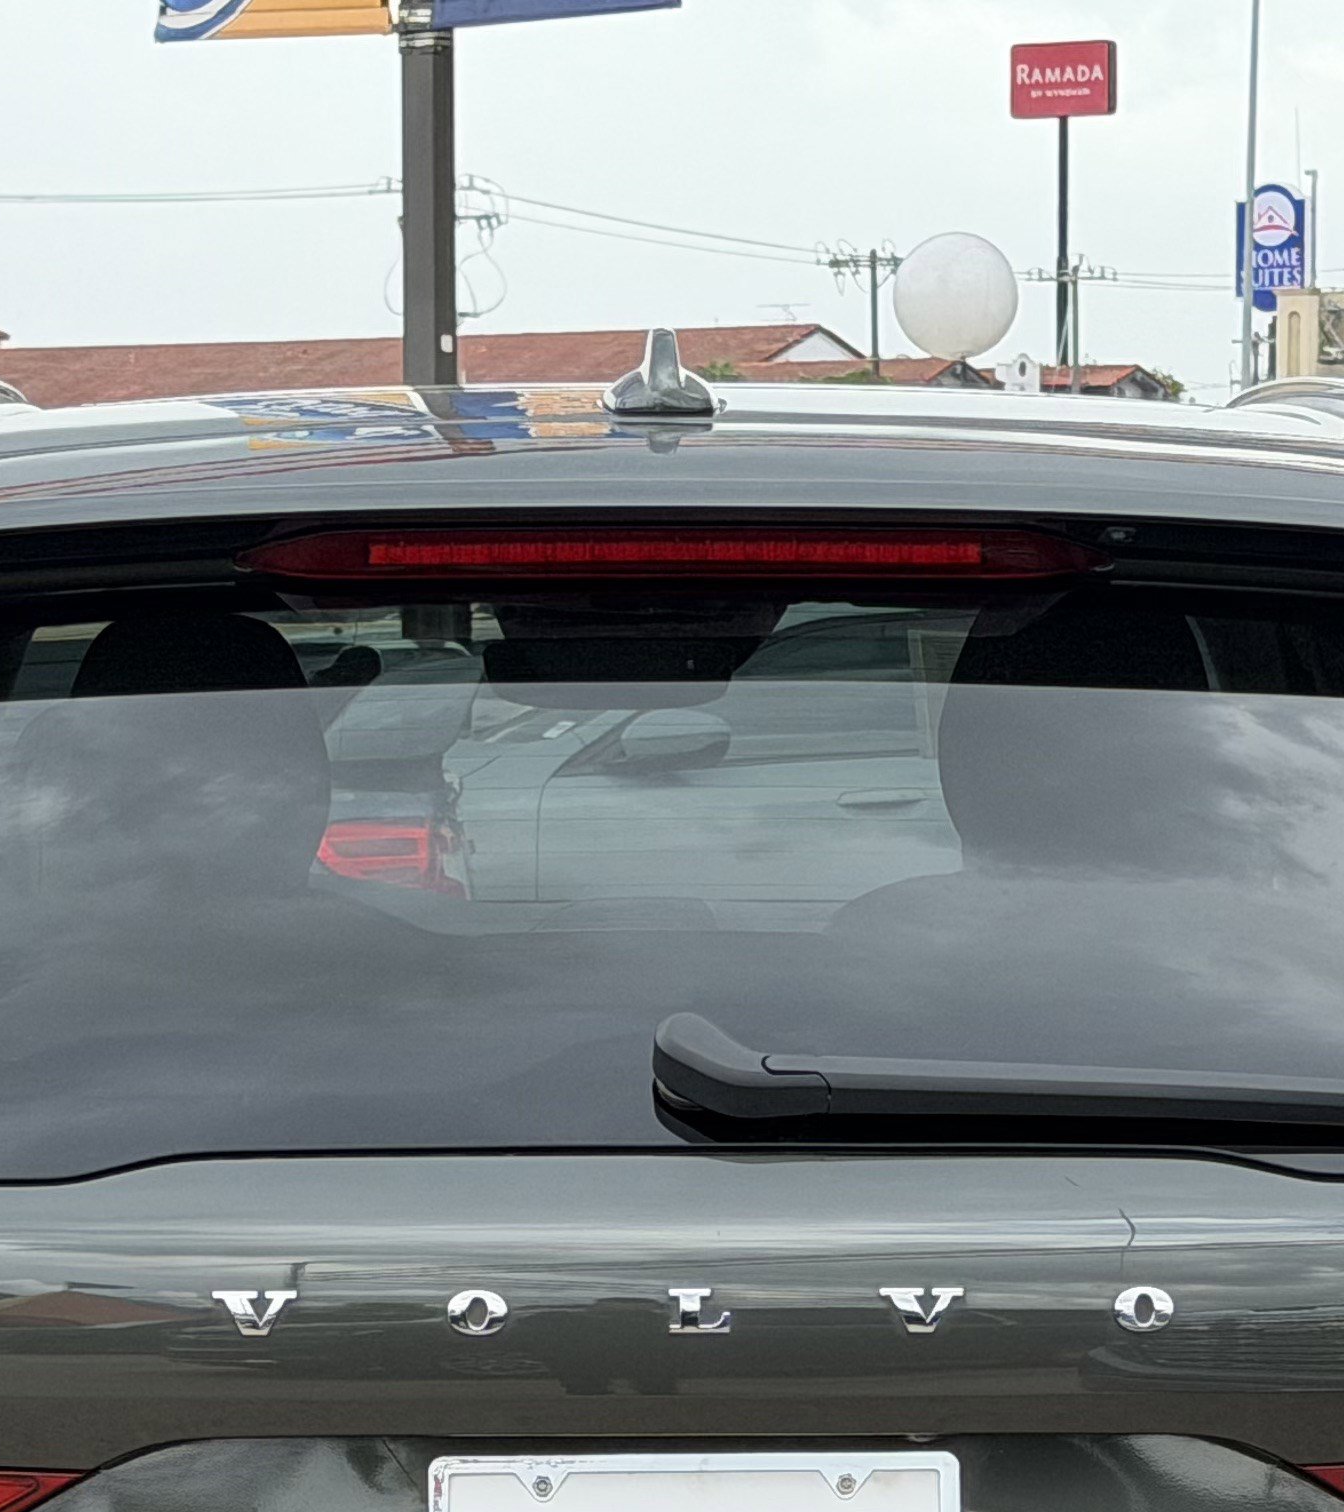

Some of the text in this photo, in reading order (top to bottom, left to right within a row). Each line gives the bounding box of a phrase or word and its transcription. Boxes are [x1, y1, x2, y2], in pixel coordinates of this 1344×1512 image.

[1016, 63, 1104, 85] RAMADA
[1252, 247, 1301, 268] OME
[212, 1286, 1175, 1337] VOLVO
